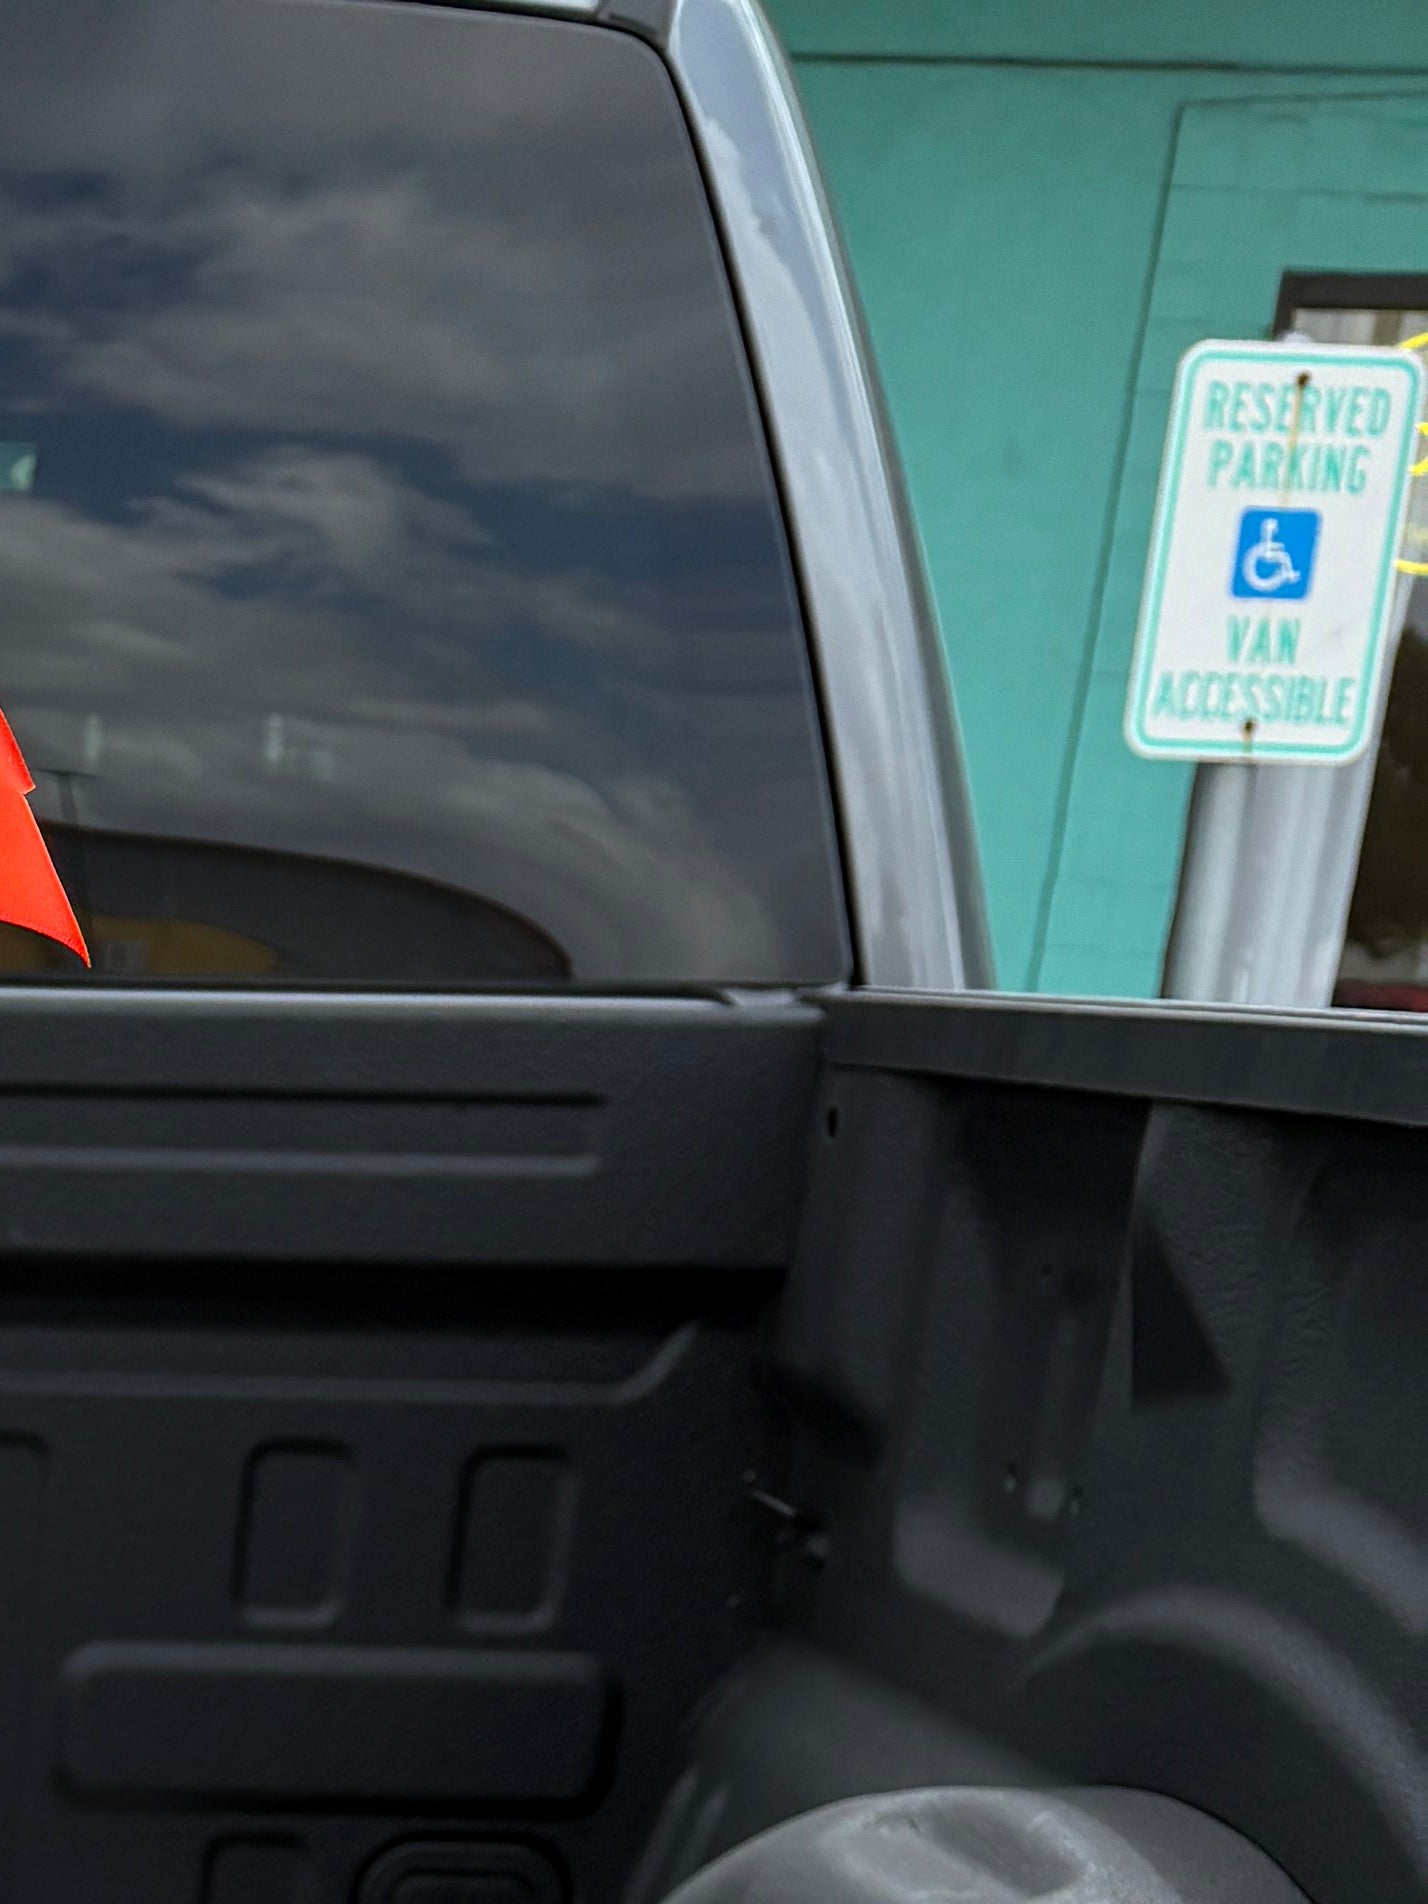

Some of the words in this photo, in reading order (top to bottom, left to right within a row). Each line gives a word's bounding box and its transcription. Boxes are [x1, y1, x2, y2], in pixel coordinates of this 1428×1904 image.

[1204, 381, 1392, 437] RESERVED
[1206, 440, 1371, 495] PARKING
[1227, 617, 1301, 665] VAN
[1154, 672, 1356, 723] ACCESSIBLE
